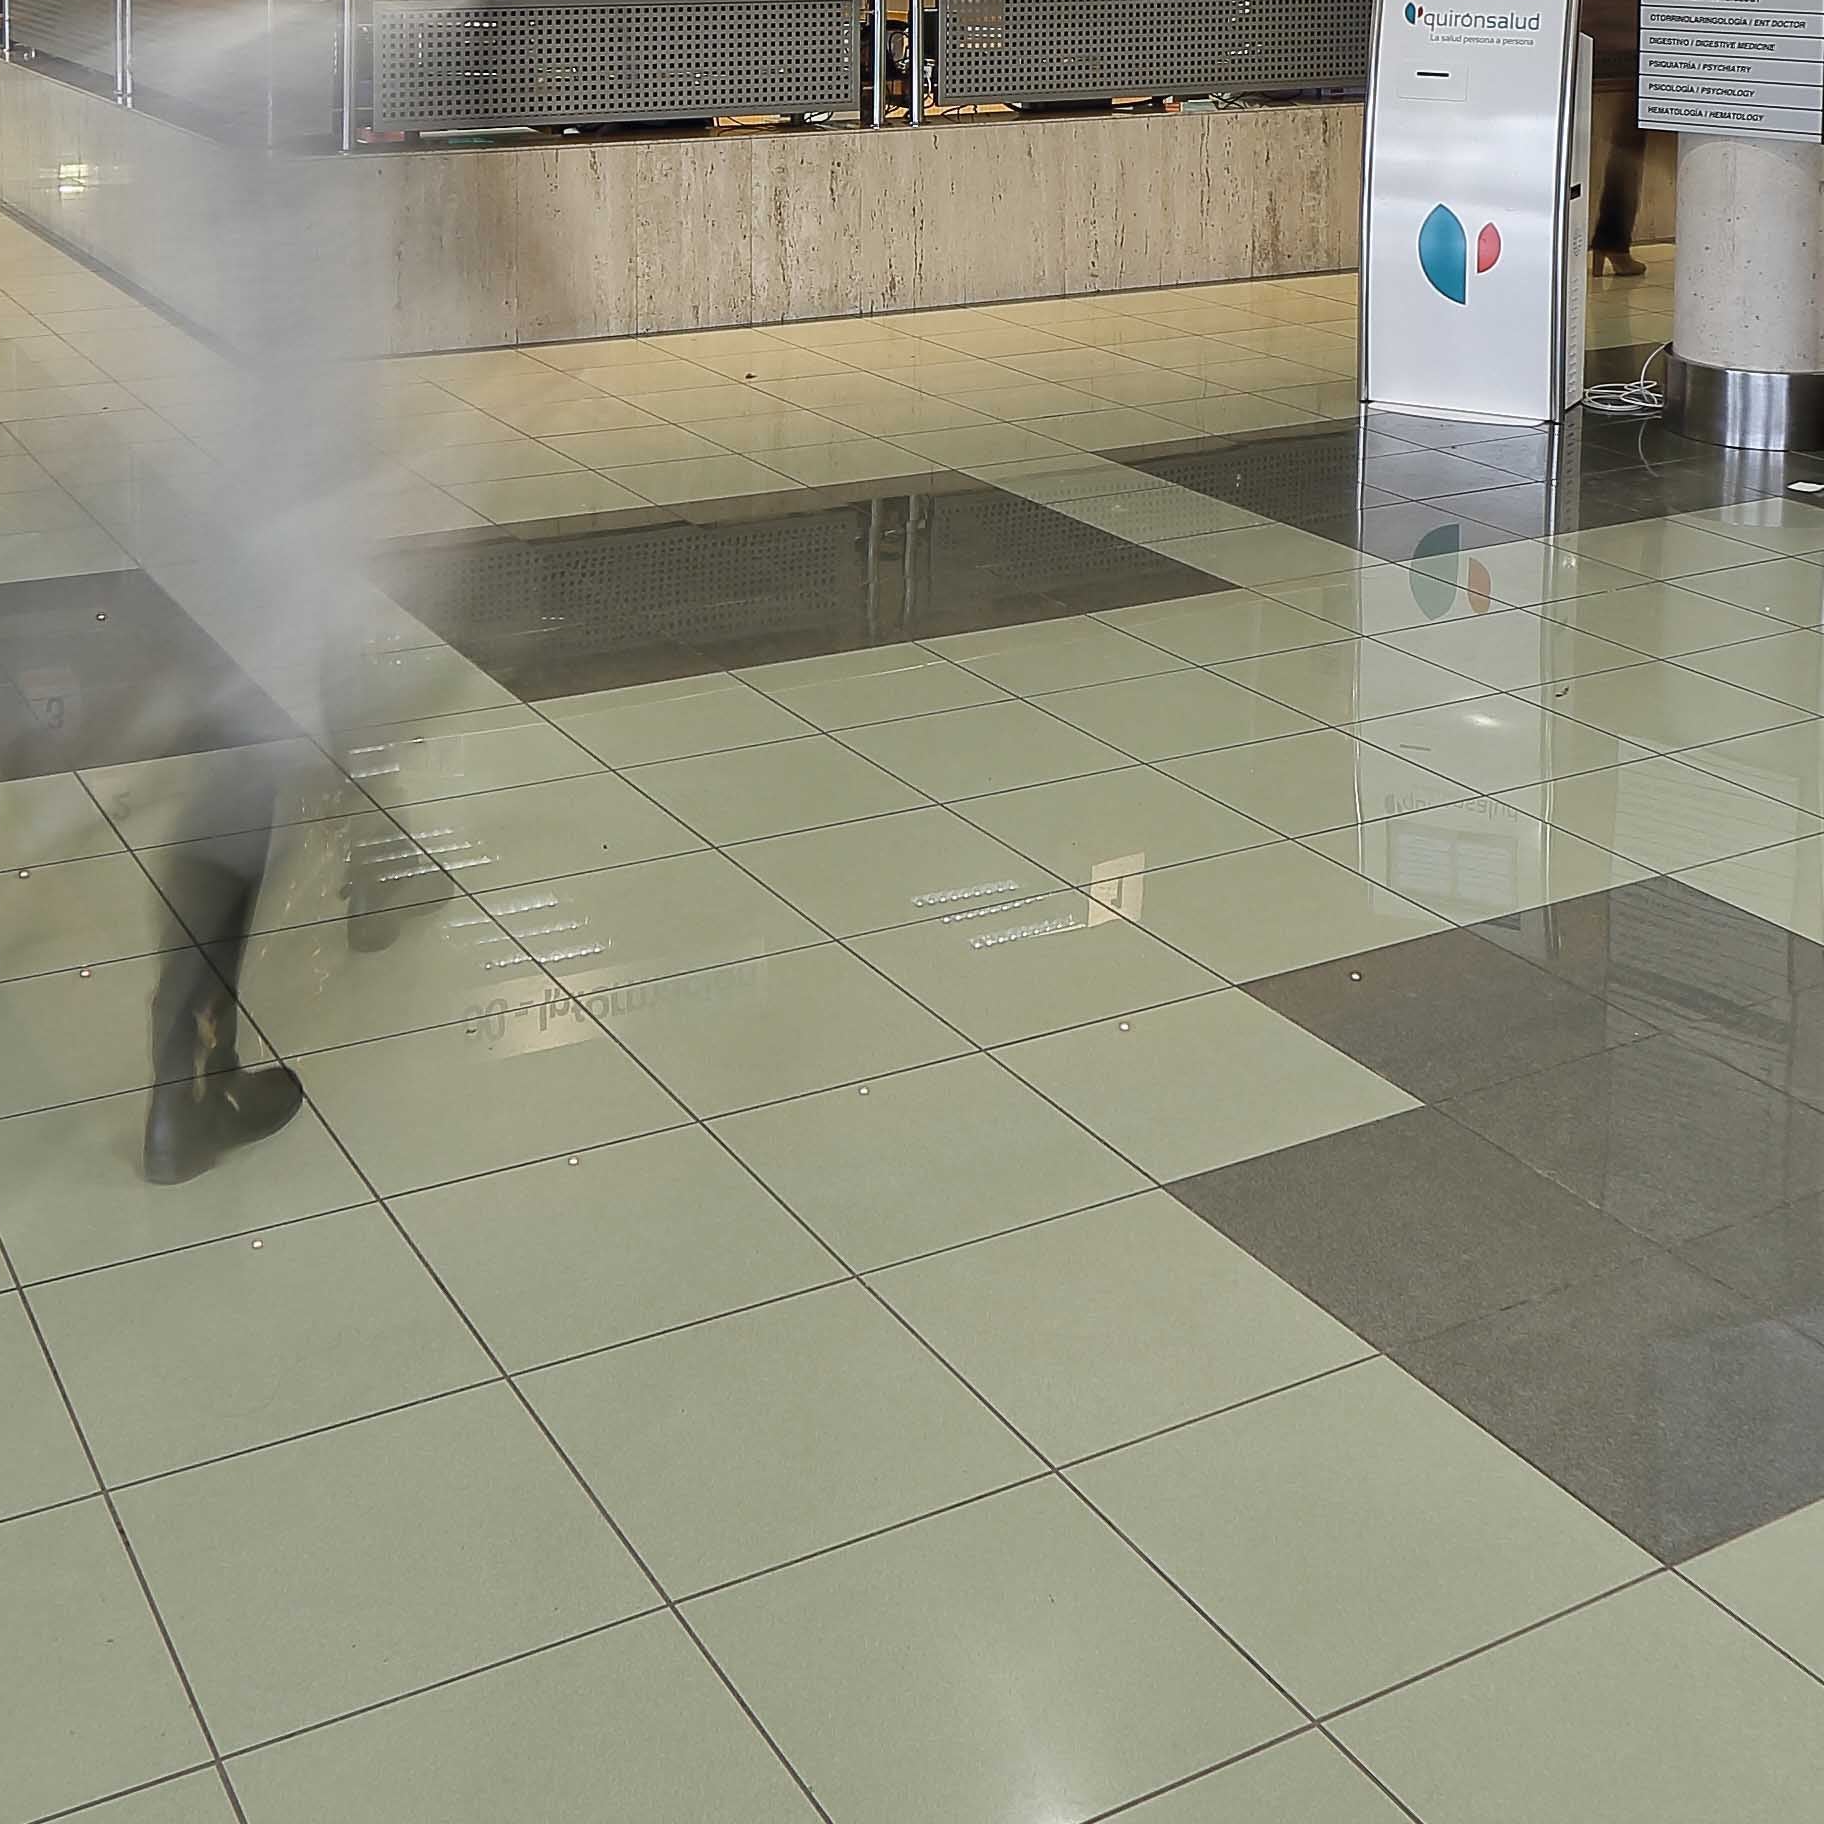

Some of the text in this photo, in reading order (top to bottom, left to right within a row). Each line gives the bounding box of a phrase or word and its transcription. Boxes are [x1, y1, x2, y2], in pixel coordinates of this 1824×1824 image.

[1423, 10, 1540, 32] quirónsalud
[1754, 19, 1771, 27] ENT
[1771, 20, 1806, 28] DOCTOR
[1430, 34, 1439, 42] La
[1441, 35, 1462, 43] salud
[1463, 36, 1494, 45] persona
[1502, 37, 1534, 46] persona
[1649, 37, 1775, 51] DIGESTIVO DIGESTIVE MEDICINE
[1703, 63, 1752, 73] PSYCHIATRY
[1701, 87, 1755, 97] PSYCHOLOGY
[1709, 111, 1764, 121] HEMATOLOGY
